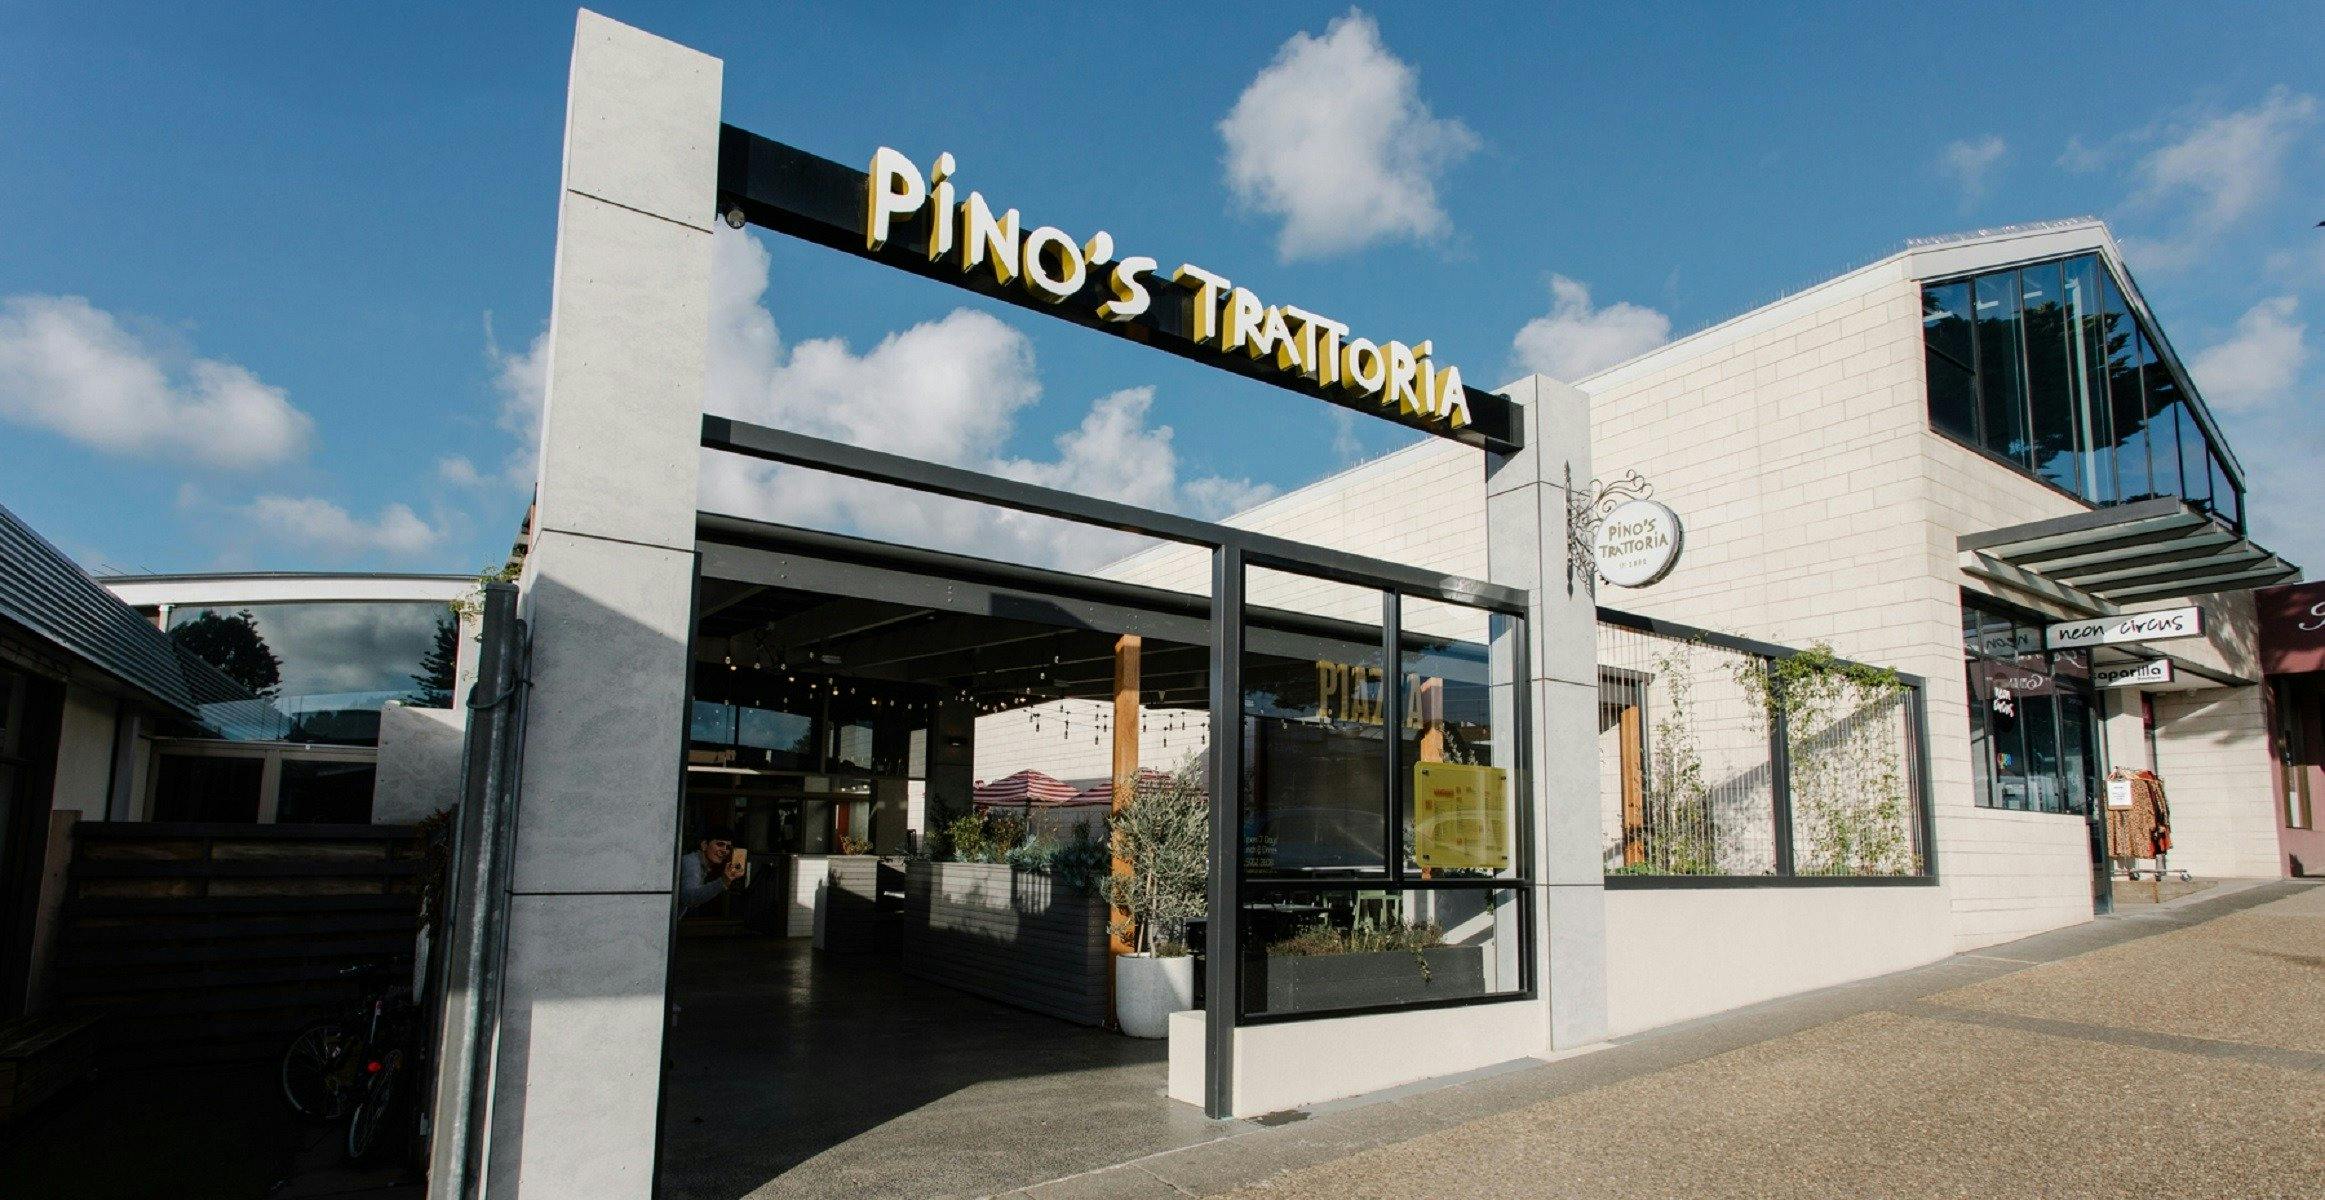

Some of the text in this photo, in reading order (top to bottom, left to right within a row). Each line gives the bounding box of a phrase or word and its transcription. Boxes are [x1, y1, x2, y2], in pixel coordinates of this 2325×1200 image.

[2059, 615, 2184, 640] neon circus
[1316, 659, 1424, 729] PIAZA
